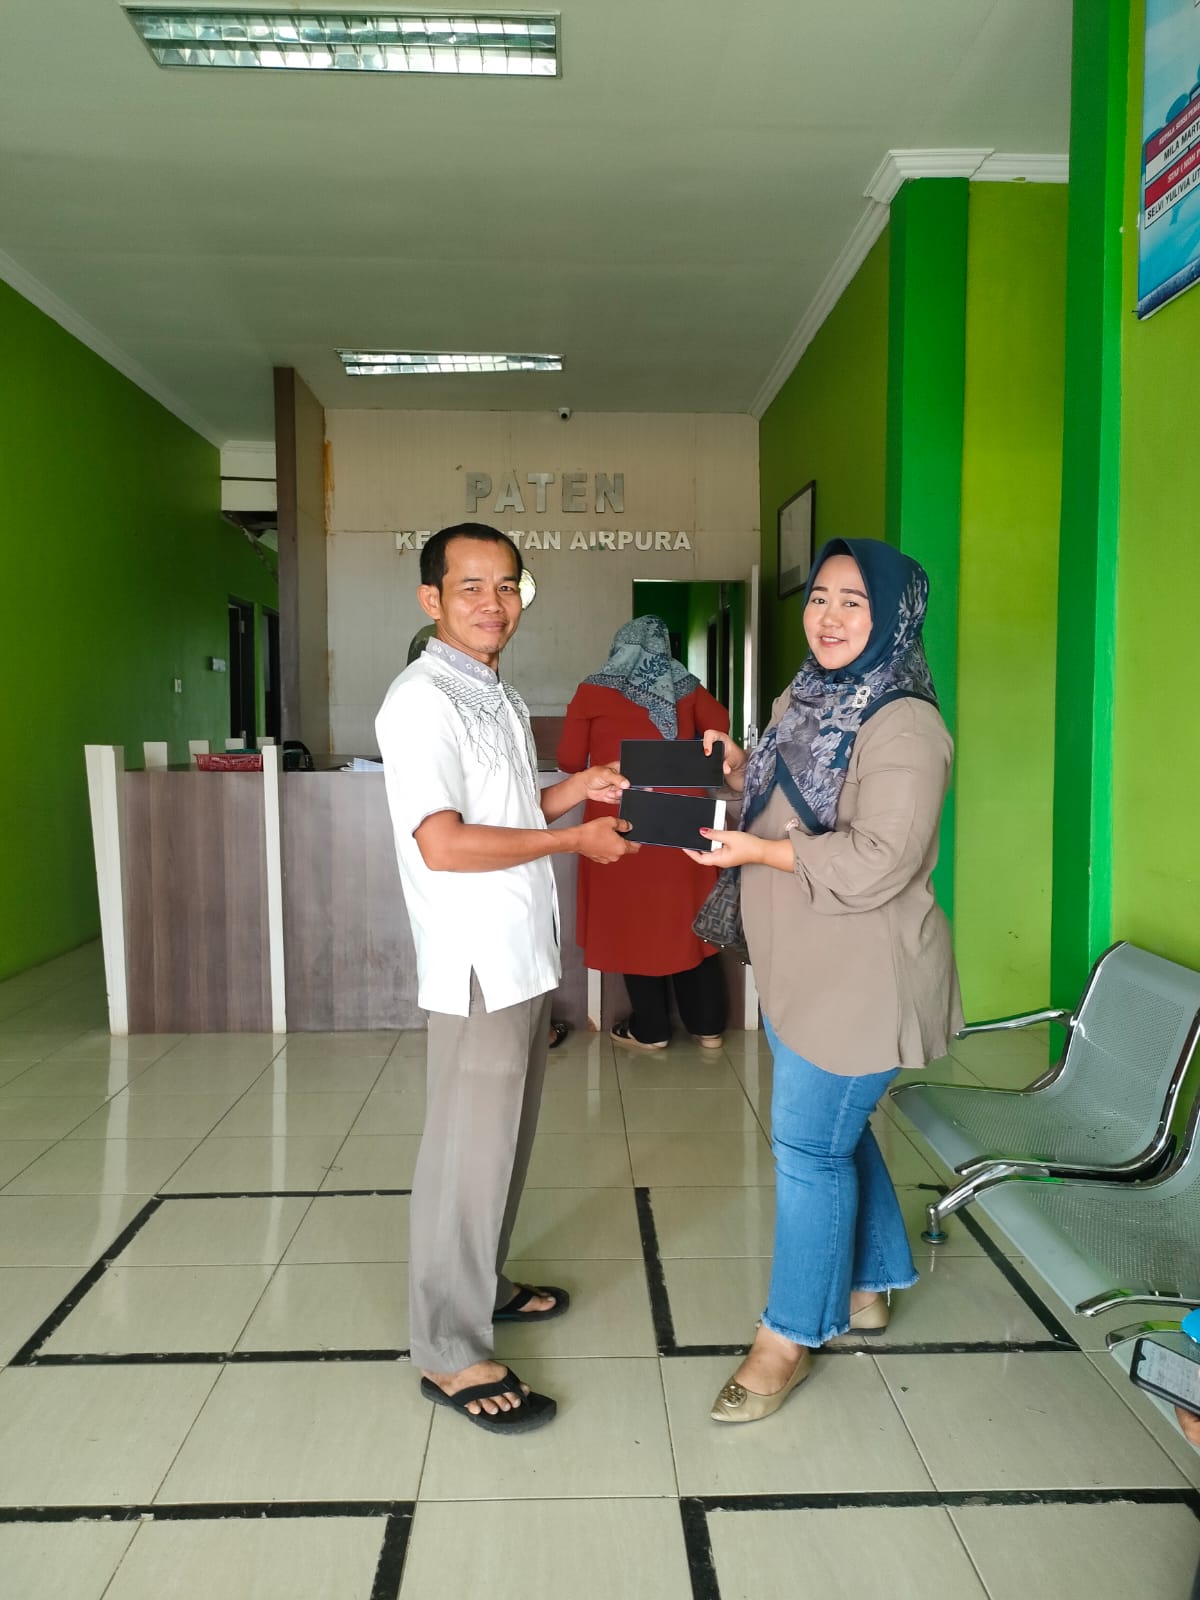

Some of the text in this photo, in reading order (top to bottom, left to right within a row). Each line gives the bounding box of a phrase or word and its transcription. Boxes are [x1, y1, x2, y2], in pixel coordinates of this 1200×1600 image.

[1163, 119, 1200, 161] MILA MART
[1147, 200, 1164, 220] SELVI
[1165, 176, 1190, 205] YULIVIA
[465, 472, 624, 513] PATEN
[569, 531, 692, 551] AIRPURA
